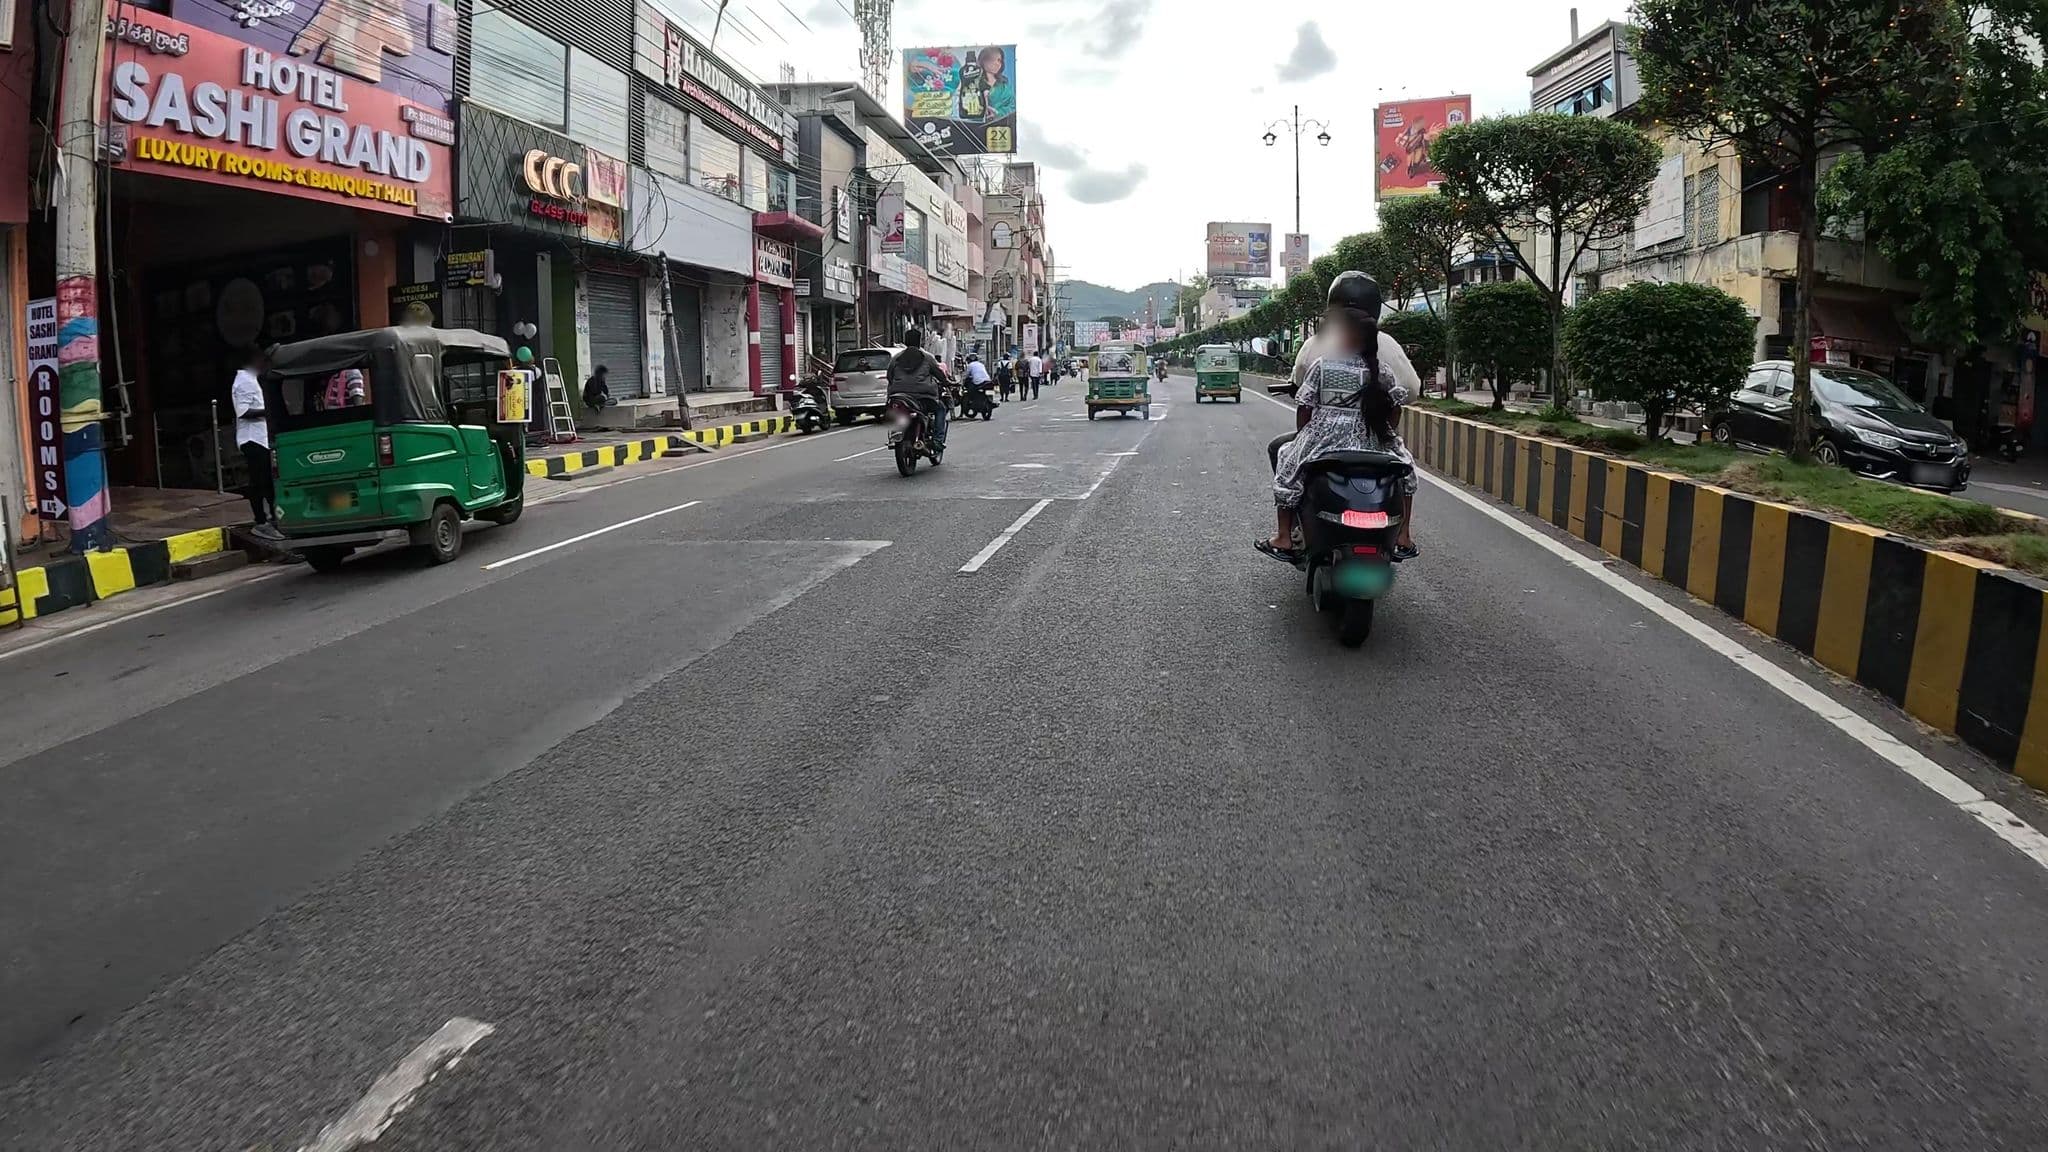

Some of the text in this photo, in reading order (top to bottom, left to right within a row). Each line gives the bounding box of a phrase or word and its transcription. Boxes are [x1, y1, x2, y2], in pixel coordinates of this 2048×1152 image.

[242, 46, 348, 113] HOTEL
[682, 39, 748, 110] HARDWARE
[112, 61, 433, 184] SASHI GRAND
[990, 130, 1008, 141] 2X
[137, 137, 418, 207] LUXURY ROOMS & BANQUET HALL
[447, 251, 486, 265] RESTAURANT
[29, 322, 56, 340] SASHI
[31, 305, 54, 321] HOTEL
[29, 343, 58, 361] GRAND
[37, 371, 58, 491] ROOMS
